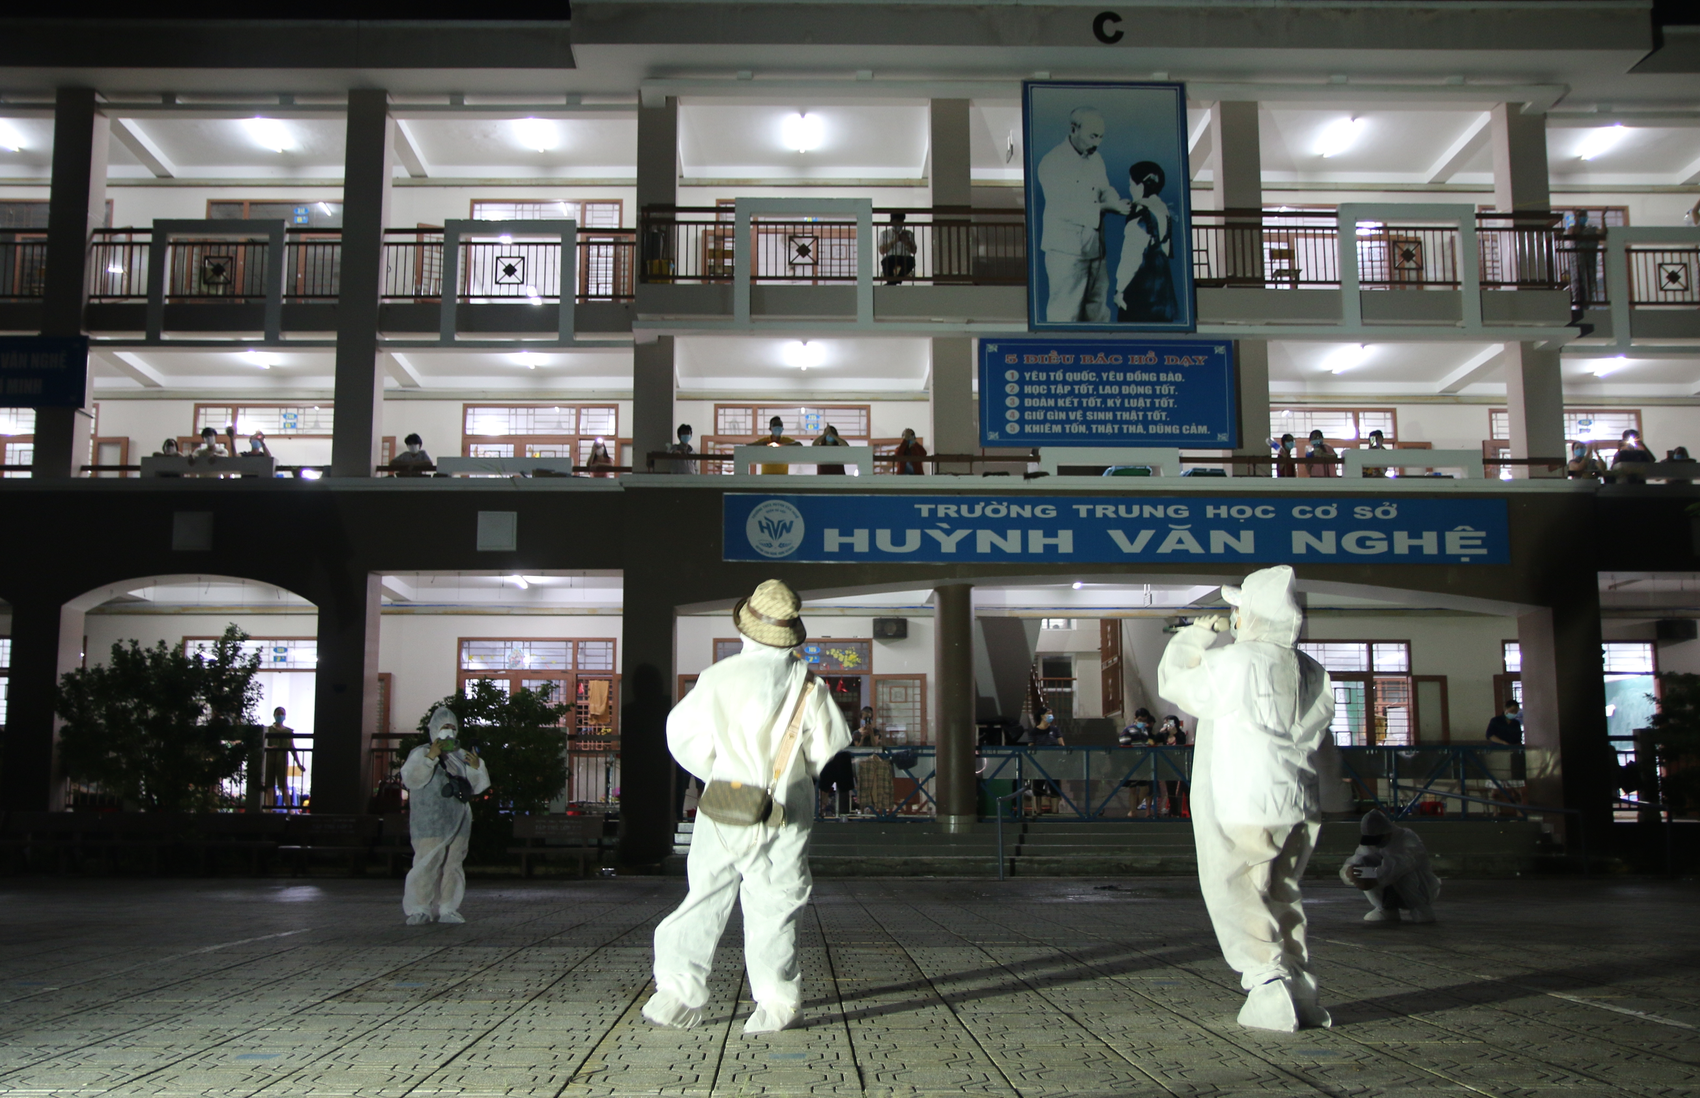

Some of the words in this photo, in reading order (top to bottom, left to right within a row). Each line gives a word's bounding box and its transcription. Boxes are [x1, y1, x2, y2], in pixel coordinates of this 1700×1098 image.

[1092, 11, 1125, 44] C
[1005, 354, 1018, 365] 5
[1023, 349, 1075, 365] ĐIỀU
[1080, 351, 1123, 365] BÁC
[1128, 350, 1158, 365] HỒ
[1164, 355, 1209, 367] DẠY
[1024, 370, 1047, 381] YÊU
[1101, 370, 1124, 381] YÊU
[1159, 370, 1185, 382] BÀO.
[1024, 385, 1047, 396] HỌC
[1050, 383, 1071, 396] TẬP
[1098, 385, 1119, 395] LAO
[1121, 384, 1153, 396] ĐỘNG
[1024, 396, 1055, 407] ĐOÀN
[1057, 396, 1079, 407] KẾT
[1124, 397, 1152, 409] LUẬT
[1024, 409, 1046, 420] GIỮ
[1046, 409, 1066, 420] GÌN
[1068, 409, 1084, 422] VỆ
[1086, 411, 1113, 420] SINH
[1115, 410, 1144, 422] THẬT
[1024, 422, 1062, 433] KHIÊM
[1091, 423, 1119, 435] THẬT
[914, 501, 1057, 518] TRƯỜNG
[1072, 503, 1190, 518] TRUNG
[1205, 504, 1276, 523] HỌC
[1291, 503, 1339, 519] CƠ
[1353, 501, 1399, 520] SỞ
[823, 522, 1074, 554] HUỲNH
[1106, 523, 1255, 554] VĂN
[1291, 525, 1488, 563] NGHỆ
